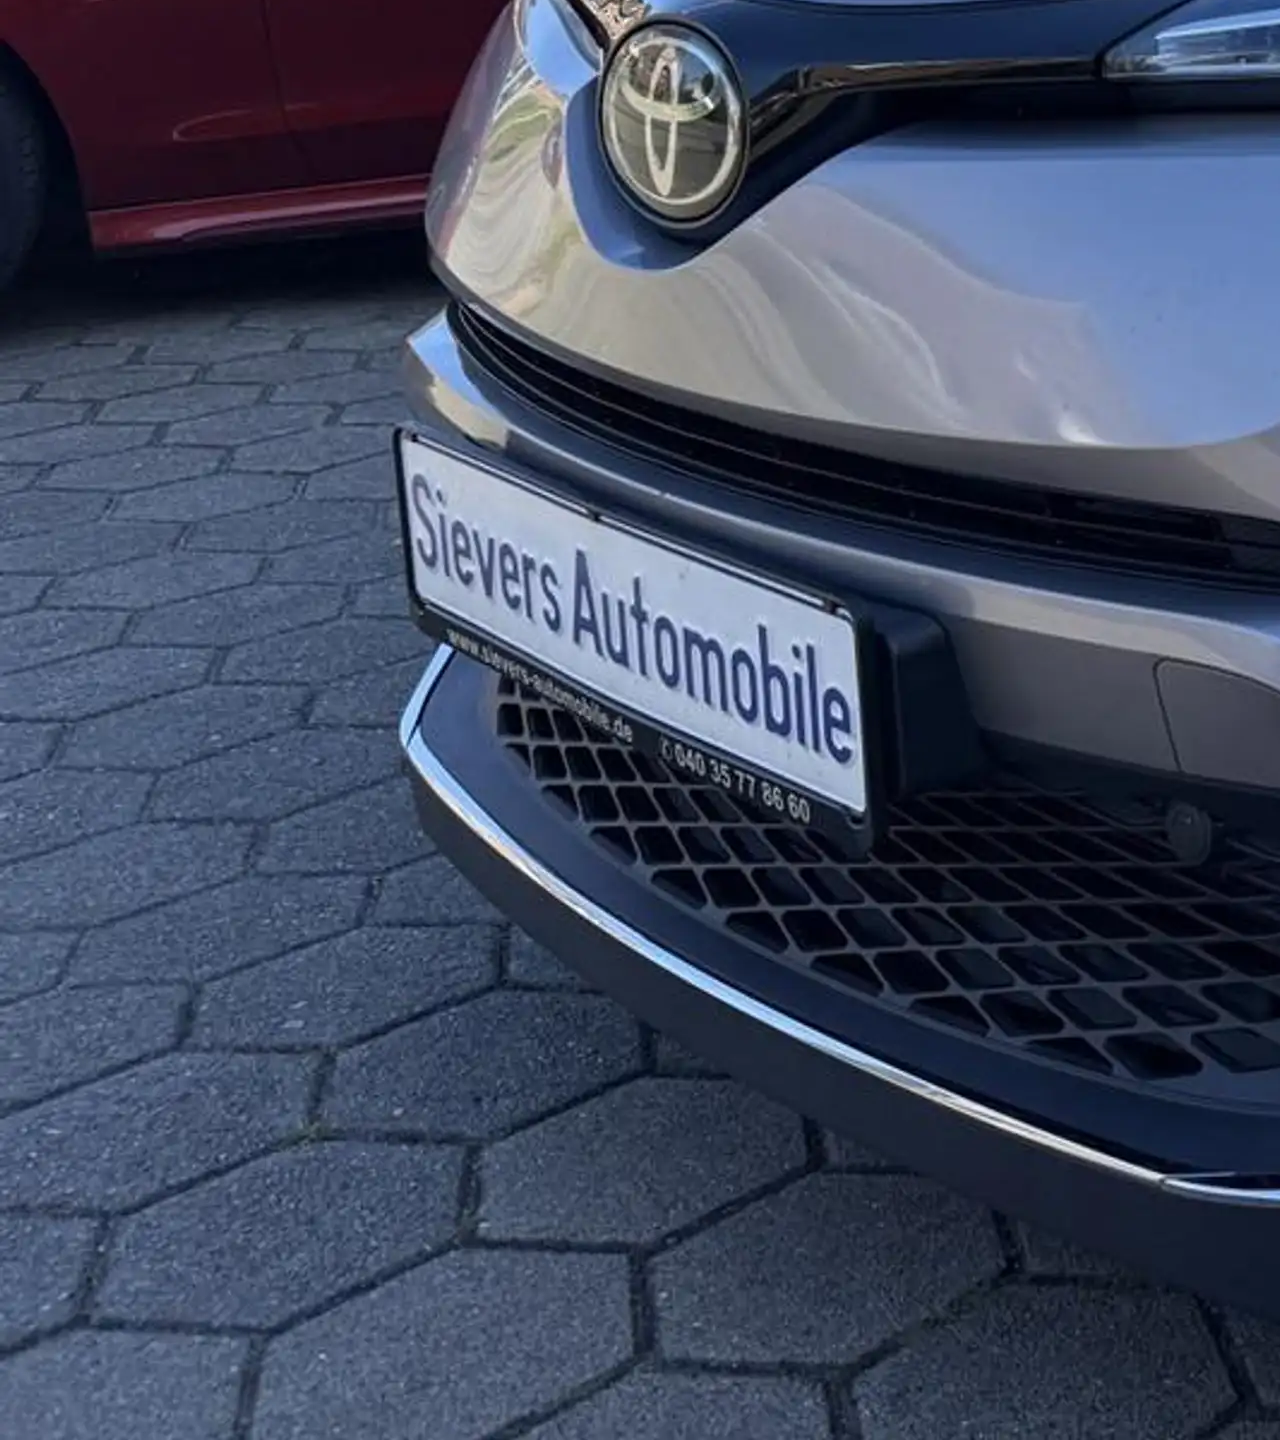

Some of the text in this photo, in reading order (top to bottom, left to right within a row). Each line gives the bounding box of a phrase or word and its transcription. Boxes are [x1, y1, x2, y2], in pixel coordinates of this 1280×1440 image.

[412, 473, 854, 764] Sievers Automobile
[709, 758, 732, 789] 35
[734, 770, 757, 799] 77
[787, 792, 811, 825] 60
